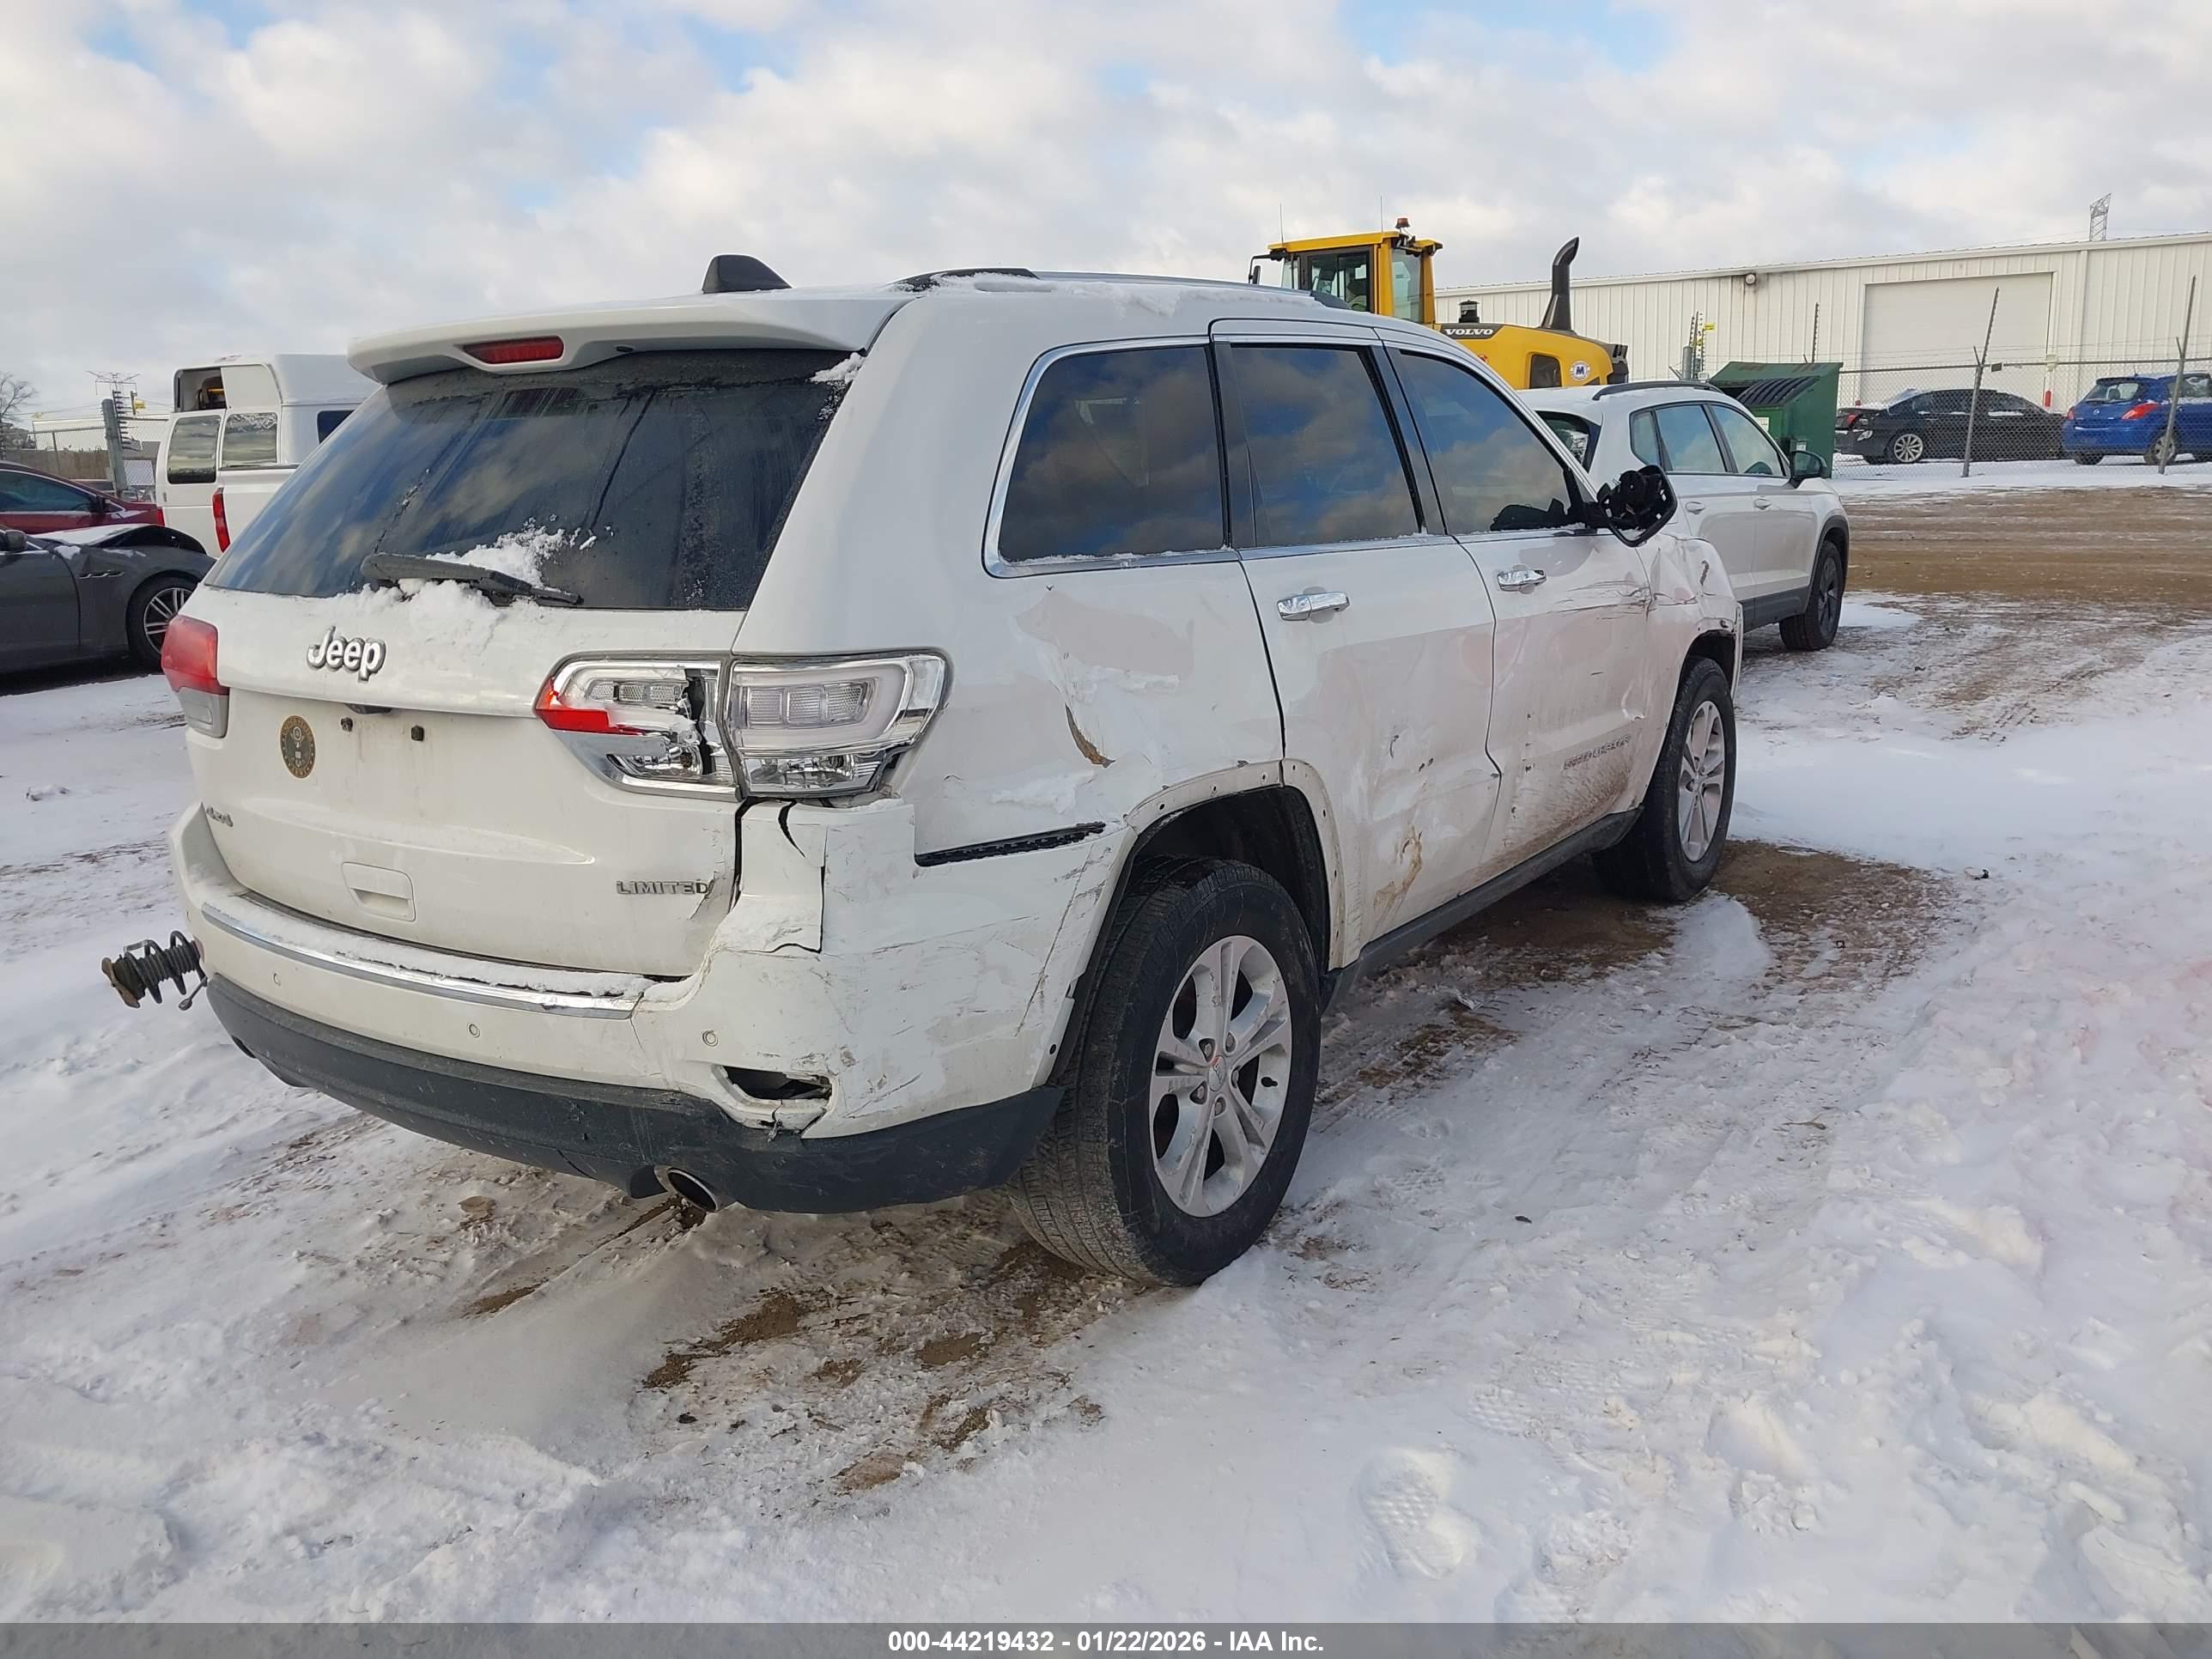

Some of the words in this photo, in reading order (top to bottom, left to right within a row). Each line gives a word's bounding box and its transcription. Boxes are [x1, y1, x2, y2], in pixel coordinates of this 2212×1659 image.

[1576, 366, 1585, 375] M
[307, 626, 386, 683] Jeep
[617, 879, 709, 895] LIMITED
